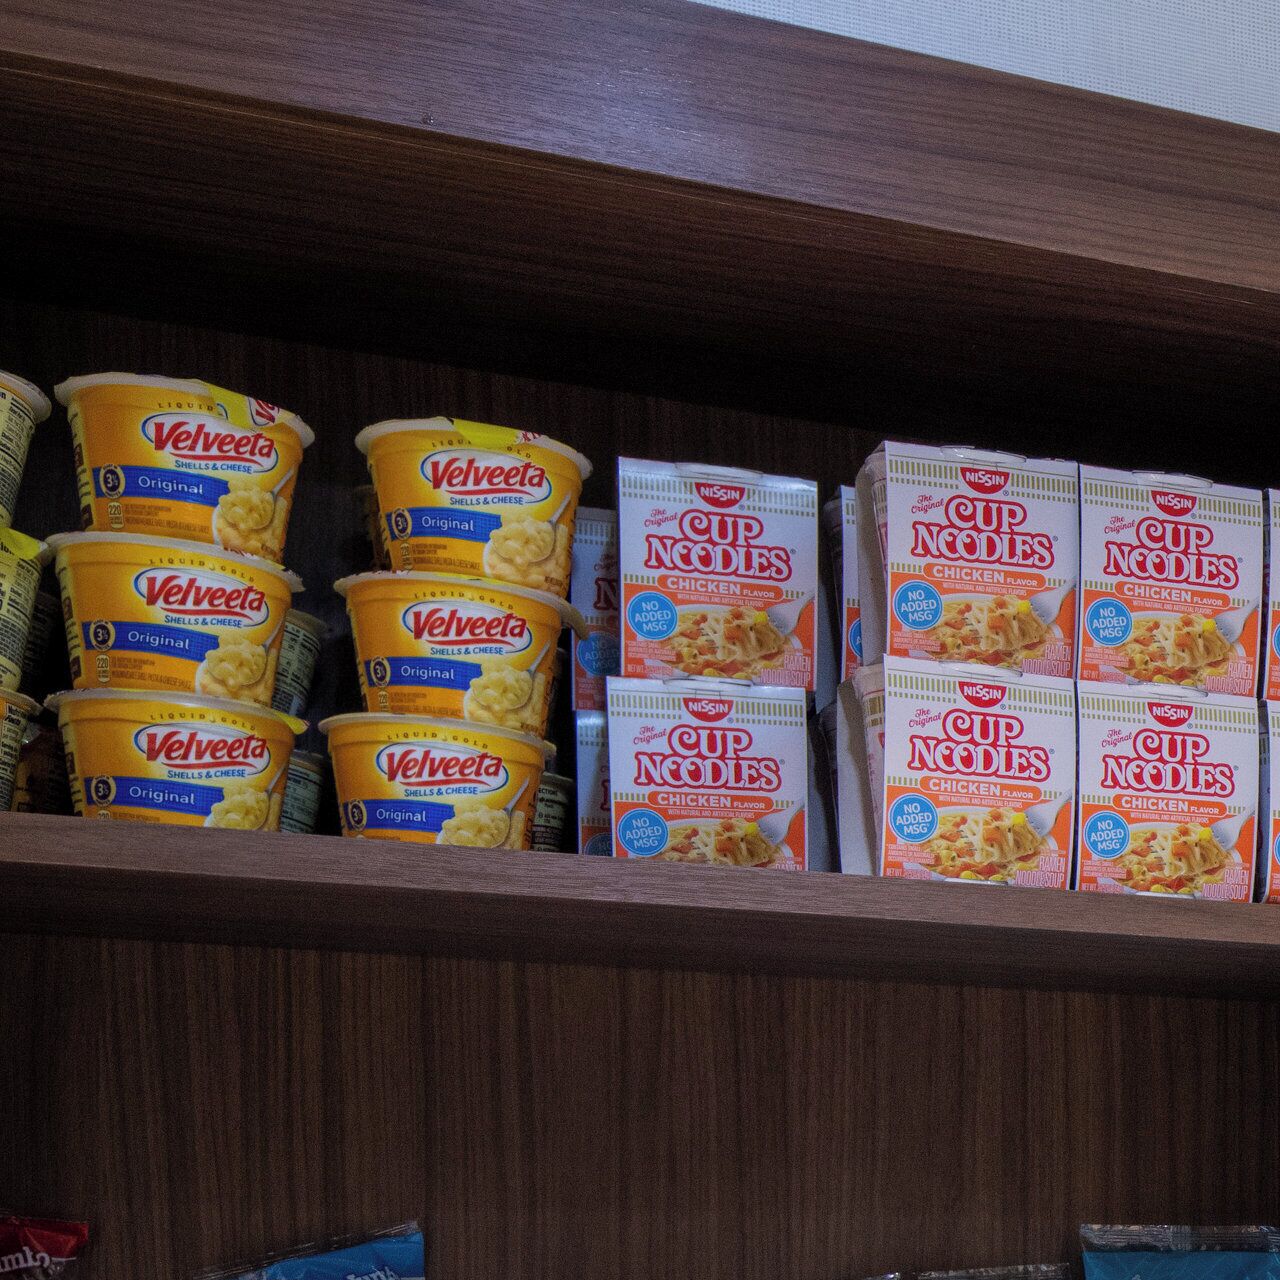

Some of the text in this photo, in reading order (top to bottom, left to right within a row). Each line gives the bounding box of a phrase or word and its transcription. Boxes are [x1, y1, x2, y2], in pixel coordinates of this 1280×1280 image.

[154, 421, 274, 458] Velveeta
[175, 460, 209, 470] SHELLS
[220, 463, 252, 474] CHEESE
[431, 458, 546, 489] Velveeta
[138, 476, 203, 495] Original
[966, 471, 1004, 486] NISSIN
[450, 497, 480, 505] SHELLS
[492, 497, 523, 505] CHEESE
[701, 486, 739, 500] NISSIN
[1157, 495, 1192, 509] NISSIN
[945, 495, 1027, 532] CUP
[422, 516, 474, 531] Original
[679, 509, 763, 546] CUP
[1136, 517, 1213, 553] CUP
[911, 521, 1054, 569] NOODLES
[644, 534, 792, 582] NOODLES
[1103, 541, 1239, 590] NOODLES
[933, 566, 1037, 586] CHICKEN FLAVOR
[146, 575, 266, 612] Velveeta
[667, 577, 775, 598] CHICKEN FLAVOR
[1124, 585, 1222, 606] CHICKEN FLAVOR
[642, 602, 658, 610] NO
[164, 615, 199, 625] SHELLS
[210, 618, 242, 628] CHEESE
[413, 608, 527, 639] Velveeta
[635, 612, 671, 622] ADDED
[128, 632, 189, 650] Original
[430, 647, 462, 655] SHELLS
[473, 647, 503, 655] CHEESE
[401, 666, 455, 680] Original
[964, 685, 1001, 700] NISSIN
[689, 701, 728, 714] NISSIN
[1153, 706, 1188, 720] NISSIN
[909, 713, 942, 728] Original
[942, 709, 1024, 745] CUP
[146, 731, 267, 761] Velveeta
[668, 724, 752, 758] CUP
[1133, 728, 1210, 763] CUP
[387, 750, 502, 782] Velveeta
[907, 735, 1050, 782] NOODLES
[167, 770, 203, 778] SHELLS
[214, 769, 246, 777] CHEESE
[634, 751, 782, 792] NOODLES
[1101, 755, 1235, 798] NOODLES
[129, 786, 195, 805] Original
[404, 788, 434, 797] SHELLS
[445, 787, 478, 795] CHEESE
[929, 780, 1033, 799] CHICKEN FLAVOR
[658, 793, 731, 807] CHICKEN
[904, 804, 920, 813] NO
[1122, 797, 1219, 814] CHICKEN FLAVOR
[376, 809, 426, 822] Original
[896, 813, 932, 825] ADDED
